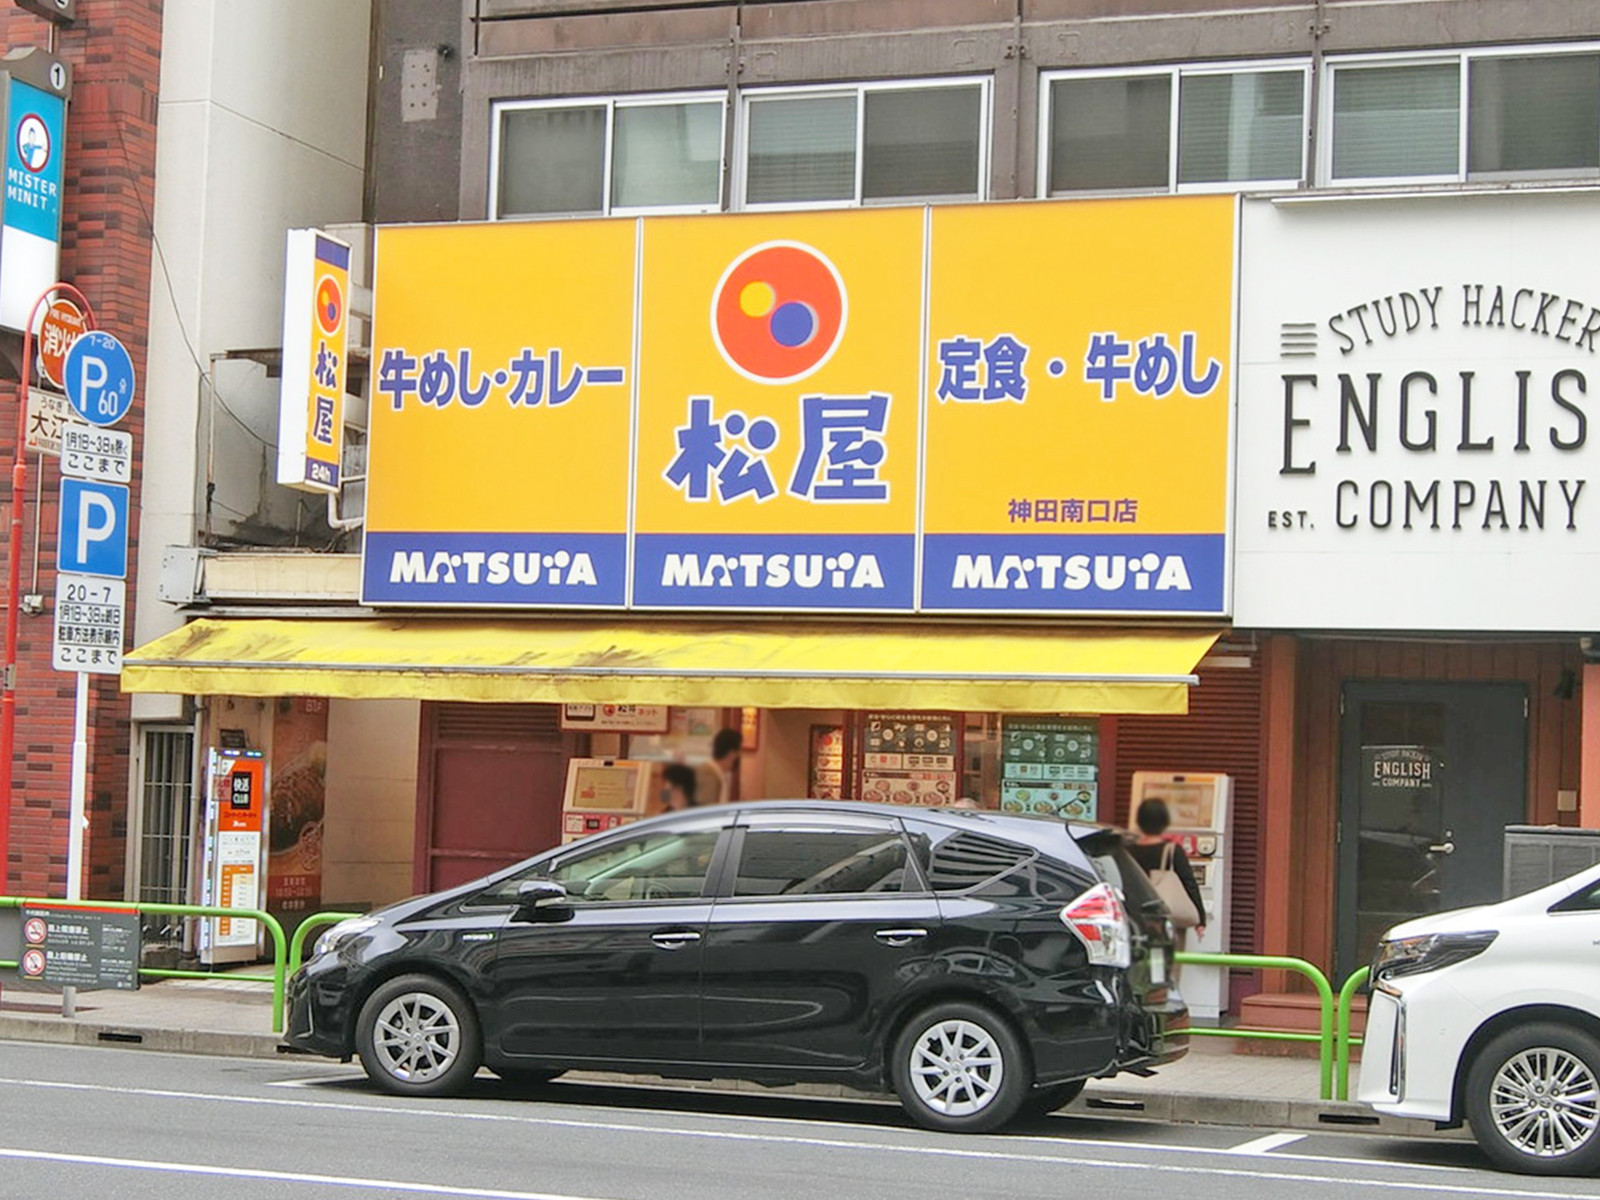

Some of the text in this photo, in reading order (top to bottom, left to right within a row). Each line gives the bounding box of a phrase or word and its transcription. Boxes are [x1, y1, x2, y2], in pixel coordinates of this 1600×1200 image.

[54, 66, 61, 87] 1
[7, 185, 48, 210] MINIT
[8, 167, 57, 197] MISTER
[1328, 286, 1444, 356] STUDY
[89, 335, 116, 350] 7-20
[79, 355, 109, 413] P
[313, 341, 338, 444] 松屋
[378, 348, 625, 411] 牛めし・カレー
[30, 411, 89, 440] 大江
[1278, 368, 1589, 475] ENGLIS
[67, 453, 125, 475] ここまで
[664, 393, 892, 502] 松屋
[1008, 498, 1138, 523] 神田南口店
[1267, 510, 1315, 529] EST.
[1335, 479, 1587, 530] COMPANY
[77, 490, 117, 564] P
[389, 550, 597, 586] MATSUYA
[661, 552, 885, 588] MATSUYA
[951, 553, 1192, 590] MATSUYA
[61, 647, 117, 665] ここまで
[1374, 761, 1431, 780] ENGLISH
[1382, 778, 1421, 787] COMPANY
